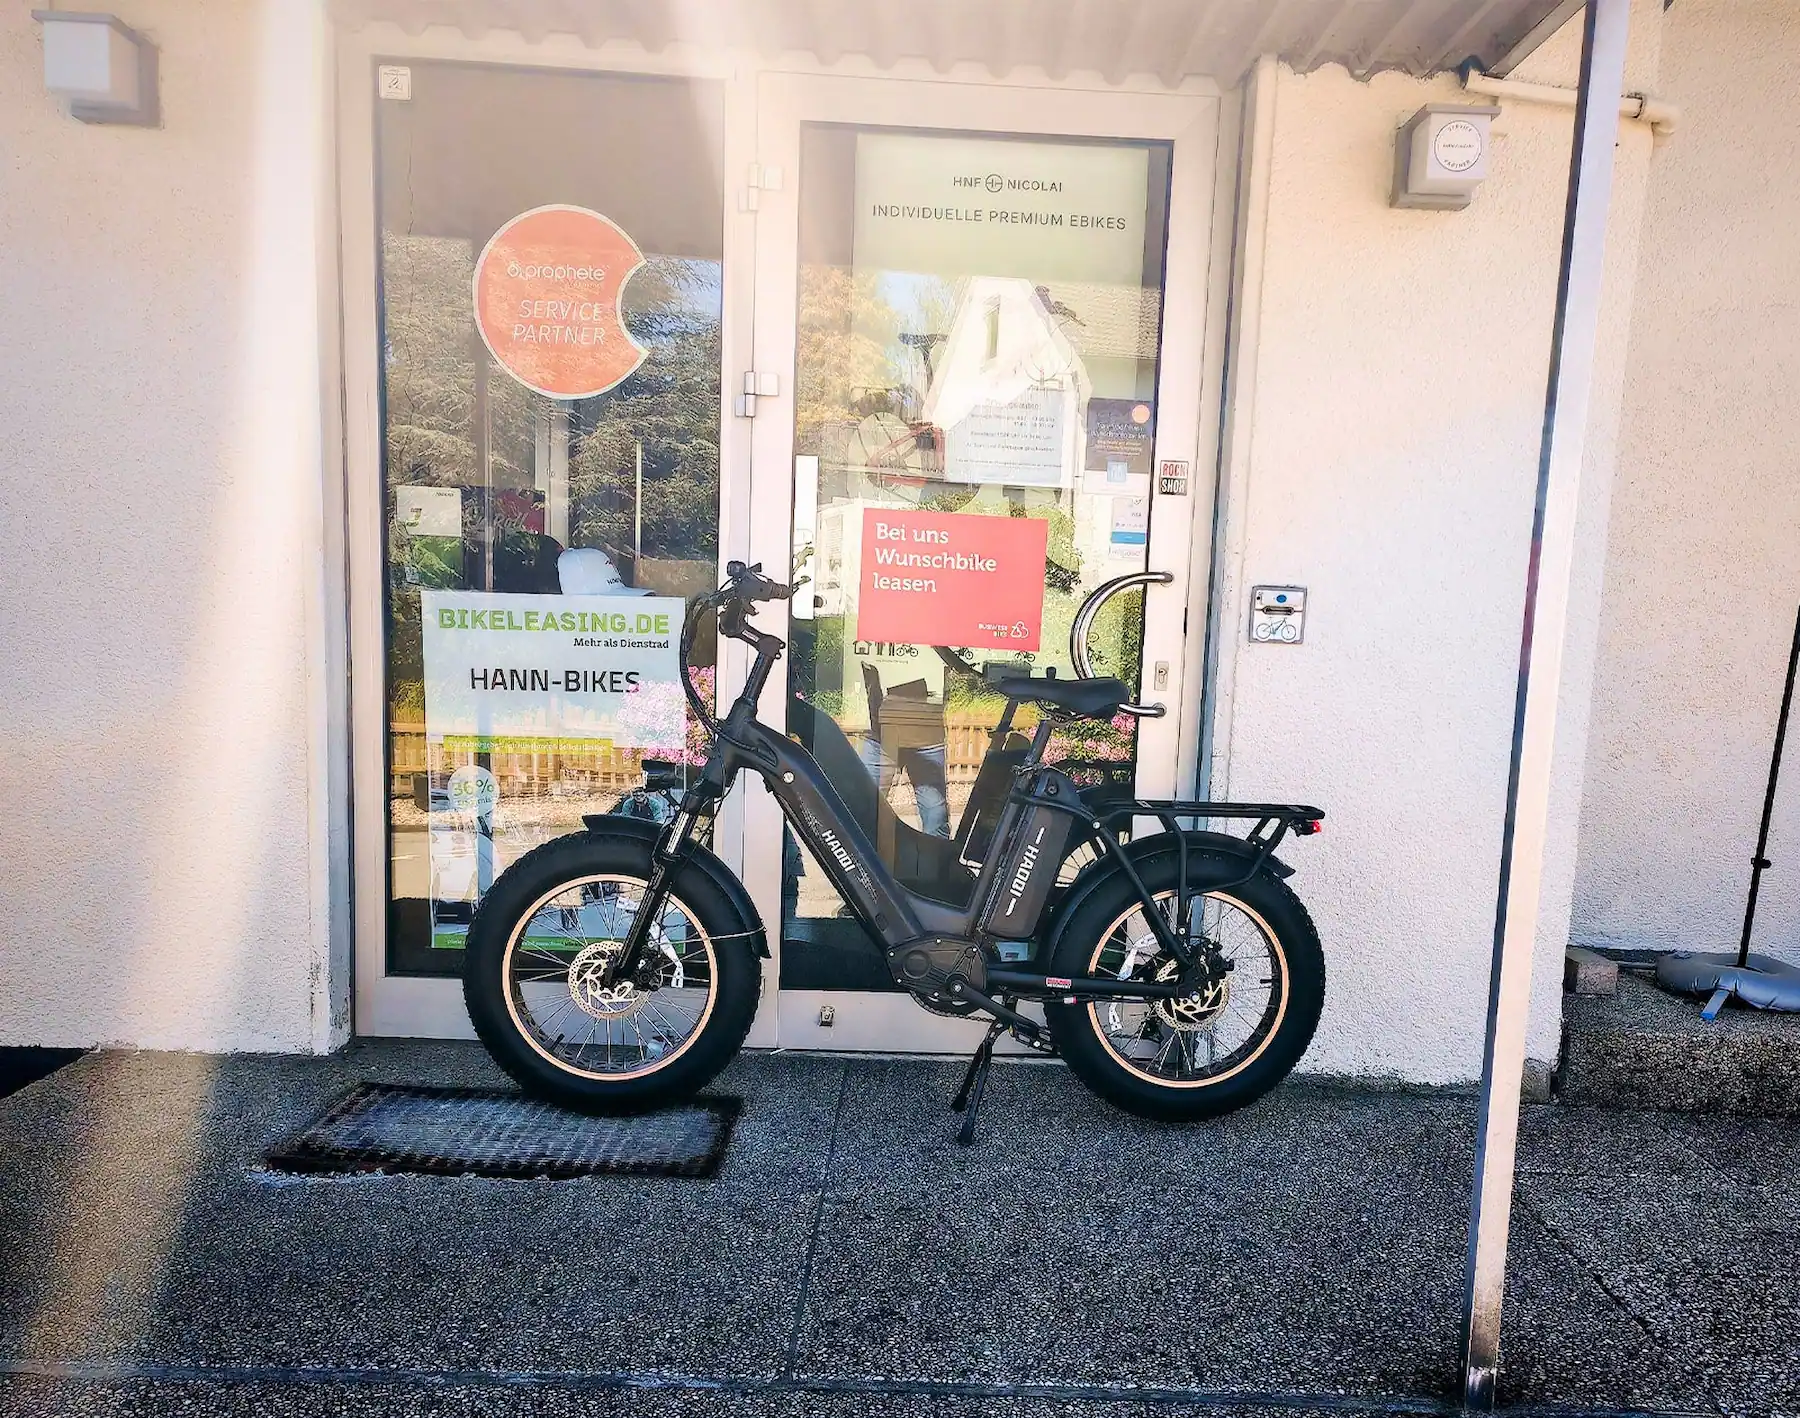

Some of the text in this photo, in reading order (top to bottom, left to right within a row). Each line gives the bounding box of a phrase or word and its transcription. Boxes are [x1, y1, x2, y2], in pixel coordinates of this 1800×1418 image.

[953, 176, 1063, 193] HNF NICOLAI
[872, 204, 1126, 231] INDIVIDUELLE PREMIUM EBIKES
[519, 299, 605, 321] SERVICE
[513, 323, 606, 345] PARTNER
[876, 522, 949, 543] Bei uns
[875, 547, 998, 572] Wunschbike
[873, 572, 937, 593] leasen
[438, 608, 670, 635] BIKELEASING.DE
[573, 637, 669, 649] Mehr als Dienstrad
[470, 668, 640, 693] HANN-BIKES
